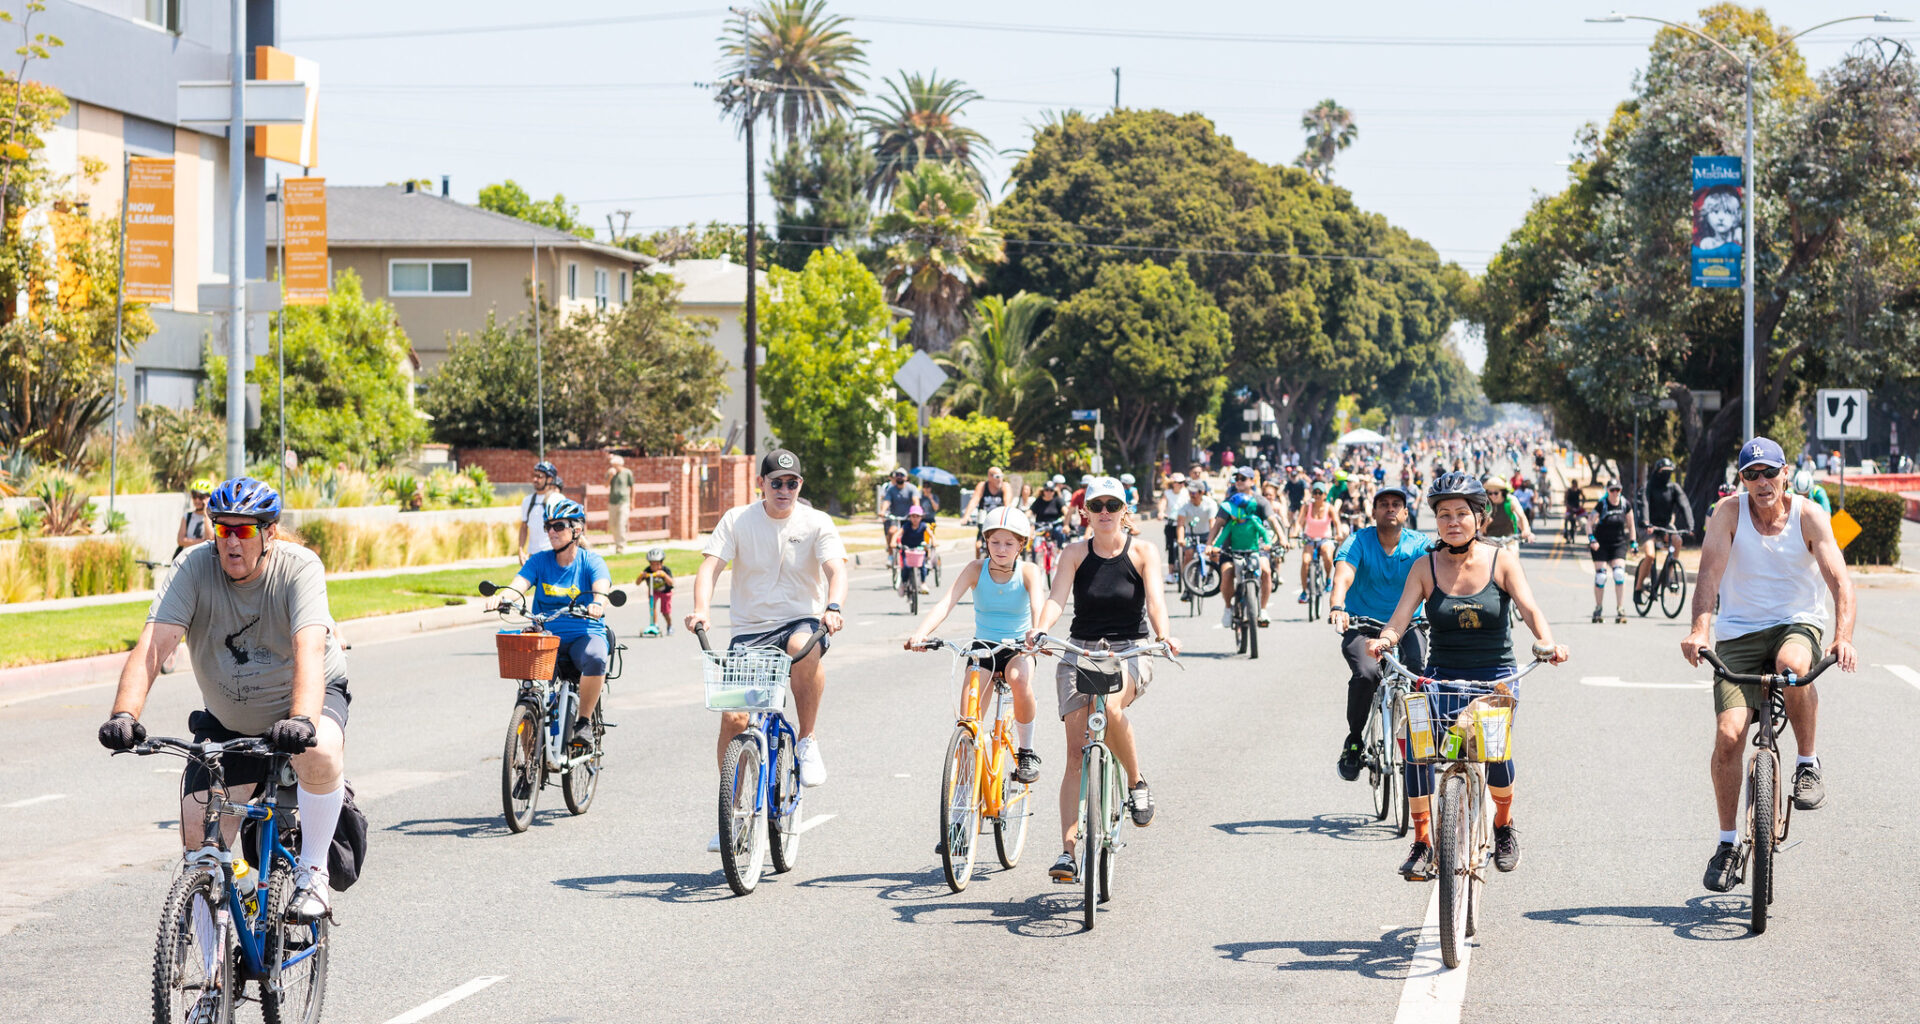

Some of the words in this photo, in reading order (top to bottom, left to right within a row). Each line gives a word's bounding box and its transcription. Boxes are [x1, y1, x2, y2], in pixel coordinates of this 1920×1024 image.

[128, 203, 155, 213] NOW
[128, 214, 174, 224] LEASING
[1752, 444, 1764, 458] LA
